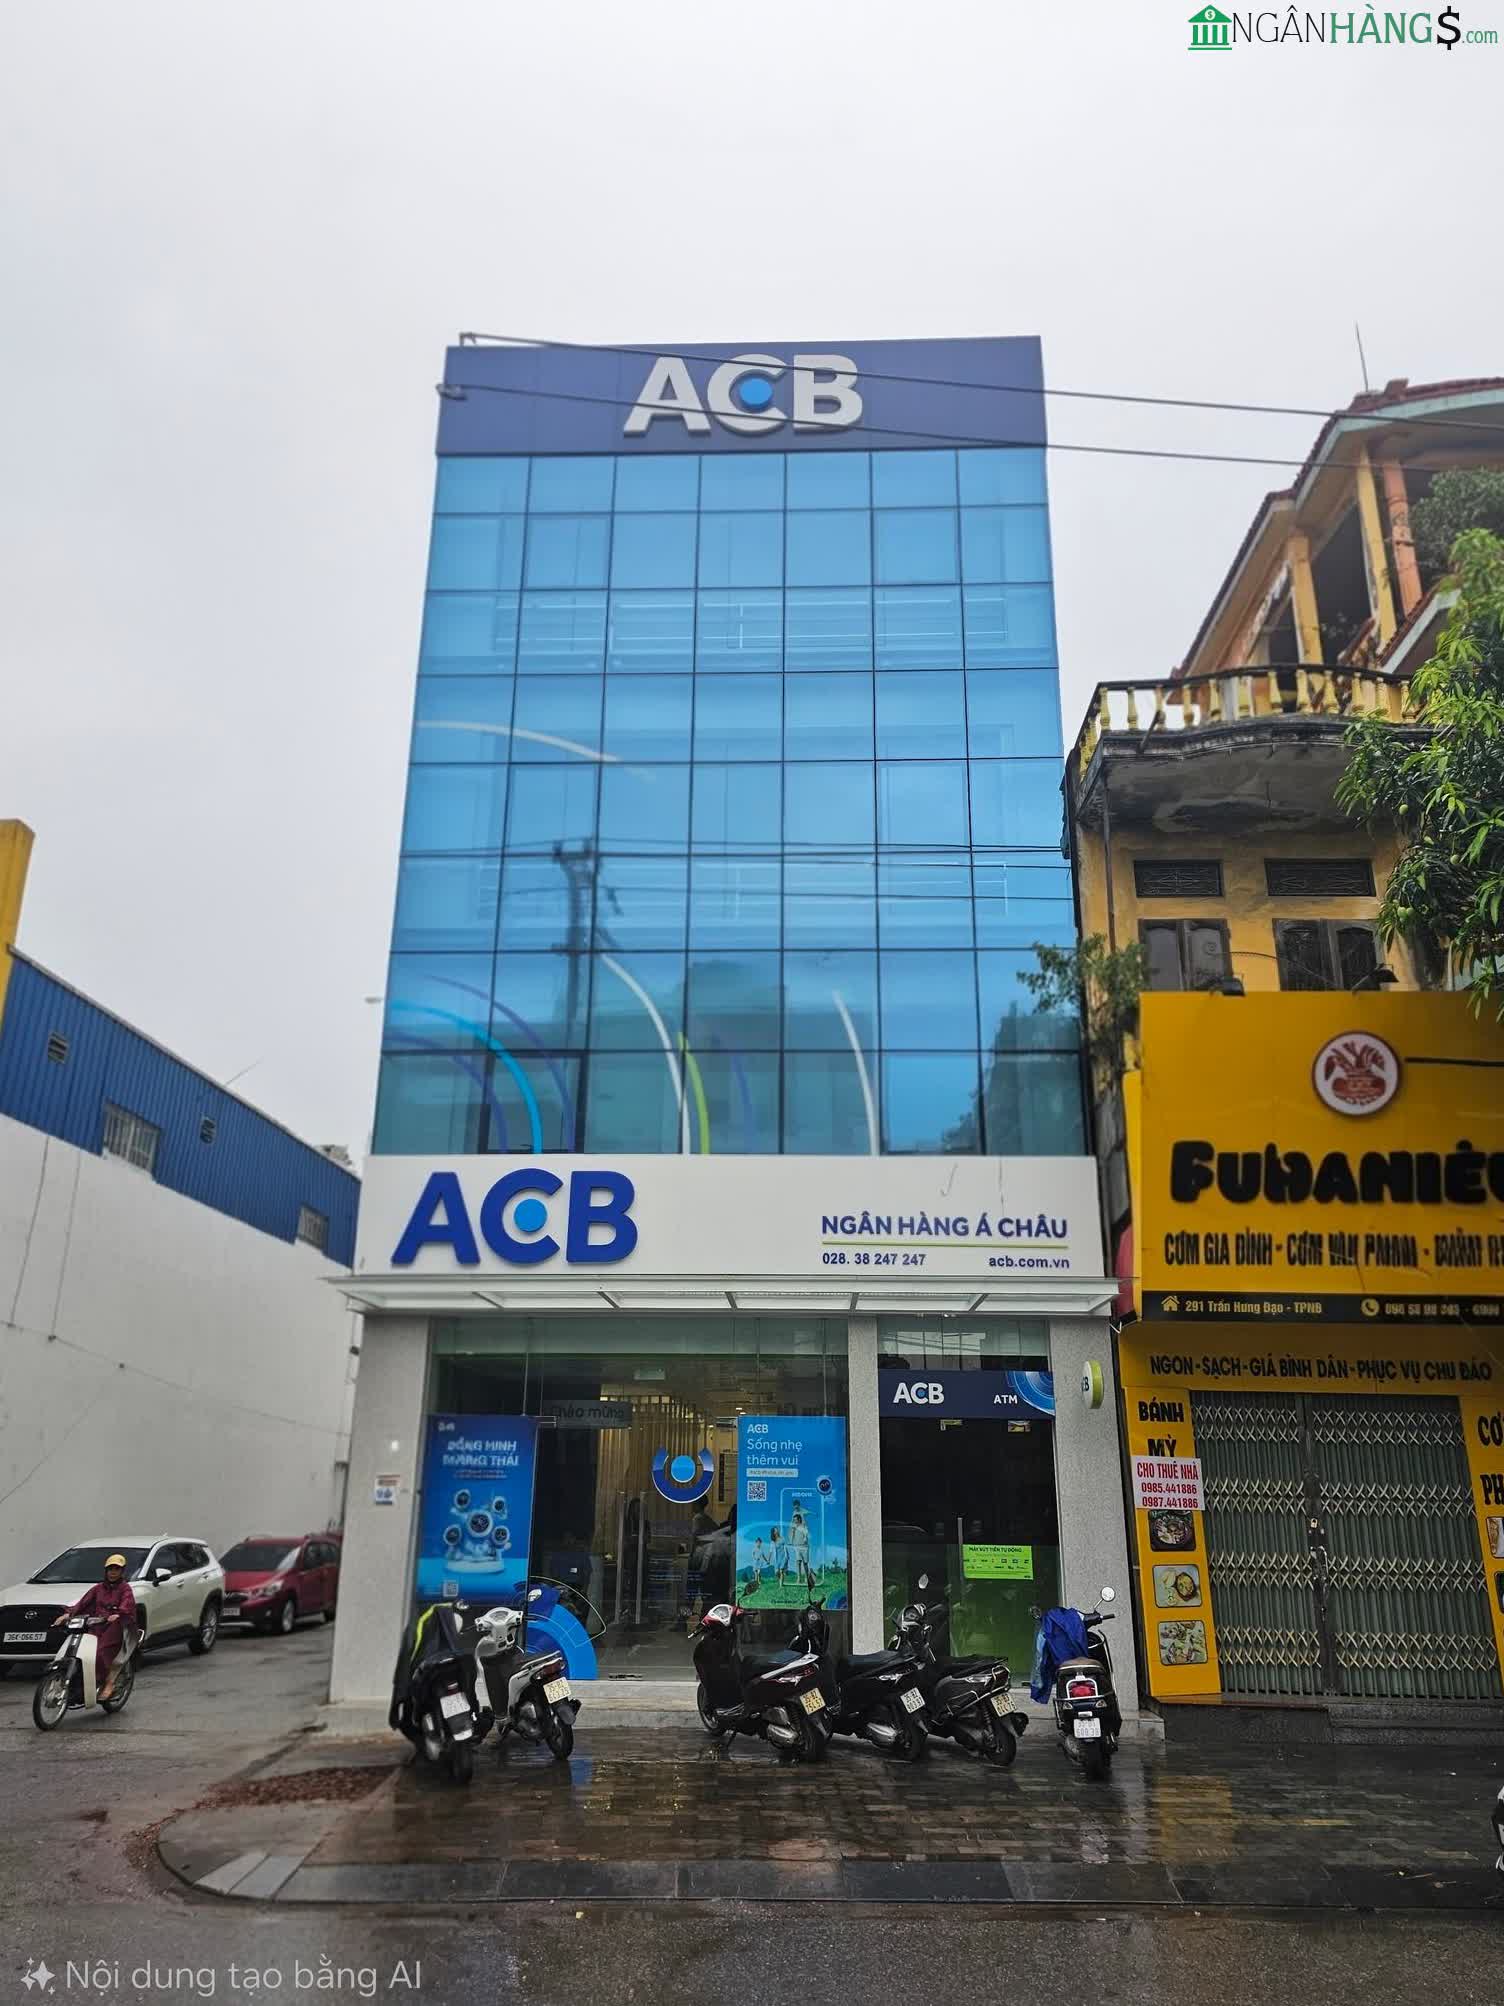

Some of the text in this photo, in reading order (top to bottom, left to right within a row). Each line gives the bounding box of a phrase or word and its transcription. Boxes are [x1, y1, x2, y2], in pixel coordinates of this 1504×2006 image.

[624, 354, 862, 434] ACB
[391, 1168, 638, 1265] ACB
[822, 1211, 1068, 1239] NGÂN HÀNG Á CHÂU
[1203, 1232, 1231, 1265] GIA
[822, 1253, 926, 1266] 028. 38 247 247
[989, 1256, 1069, 1268] acb.com.vn
[1185, 1300, 1204, 1312] 291
[1279, 1353, 1313, 1377] BÌNH
[1400, 1360, 1421, 1383] VỤ
[893, 1382, 1018, 1404] ACB ATM
[1138, 1397, 1184, 1422] BÁNH
[747, 1424, 768, 1433] ACB
[747, 1438, 802, 1452] Sống nhẹ
[747, 1454, 799, 1465] thêm vui
[1137, 1461, 1199, 1480] CHO THUÊ NHÀ
[1141, 1482, 1198, 1494] 0985.441886
[1142, 1497, 1199, 1509] 0987.441886
